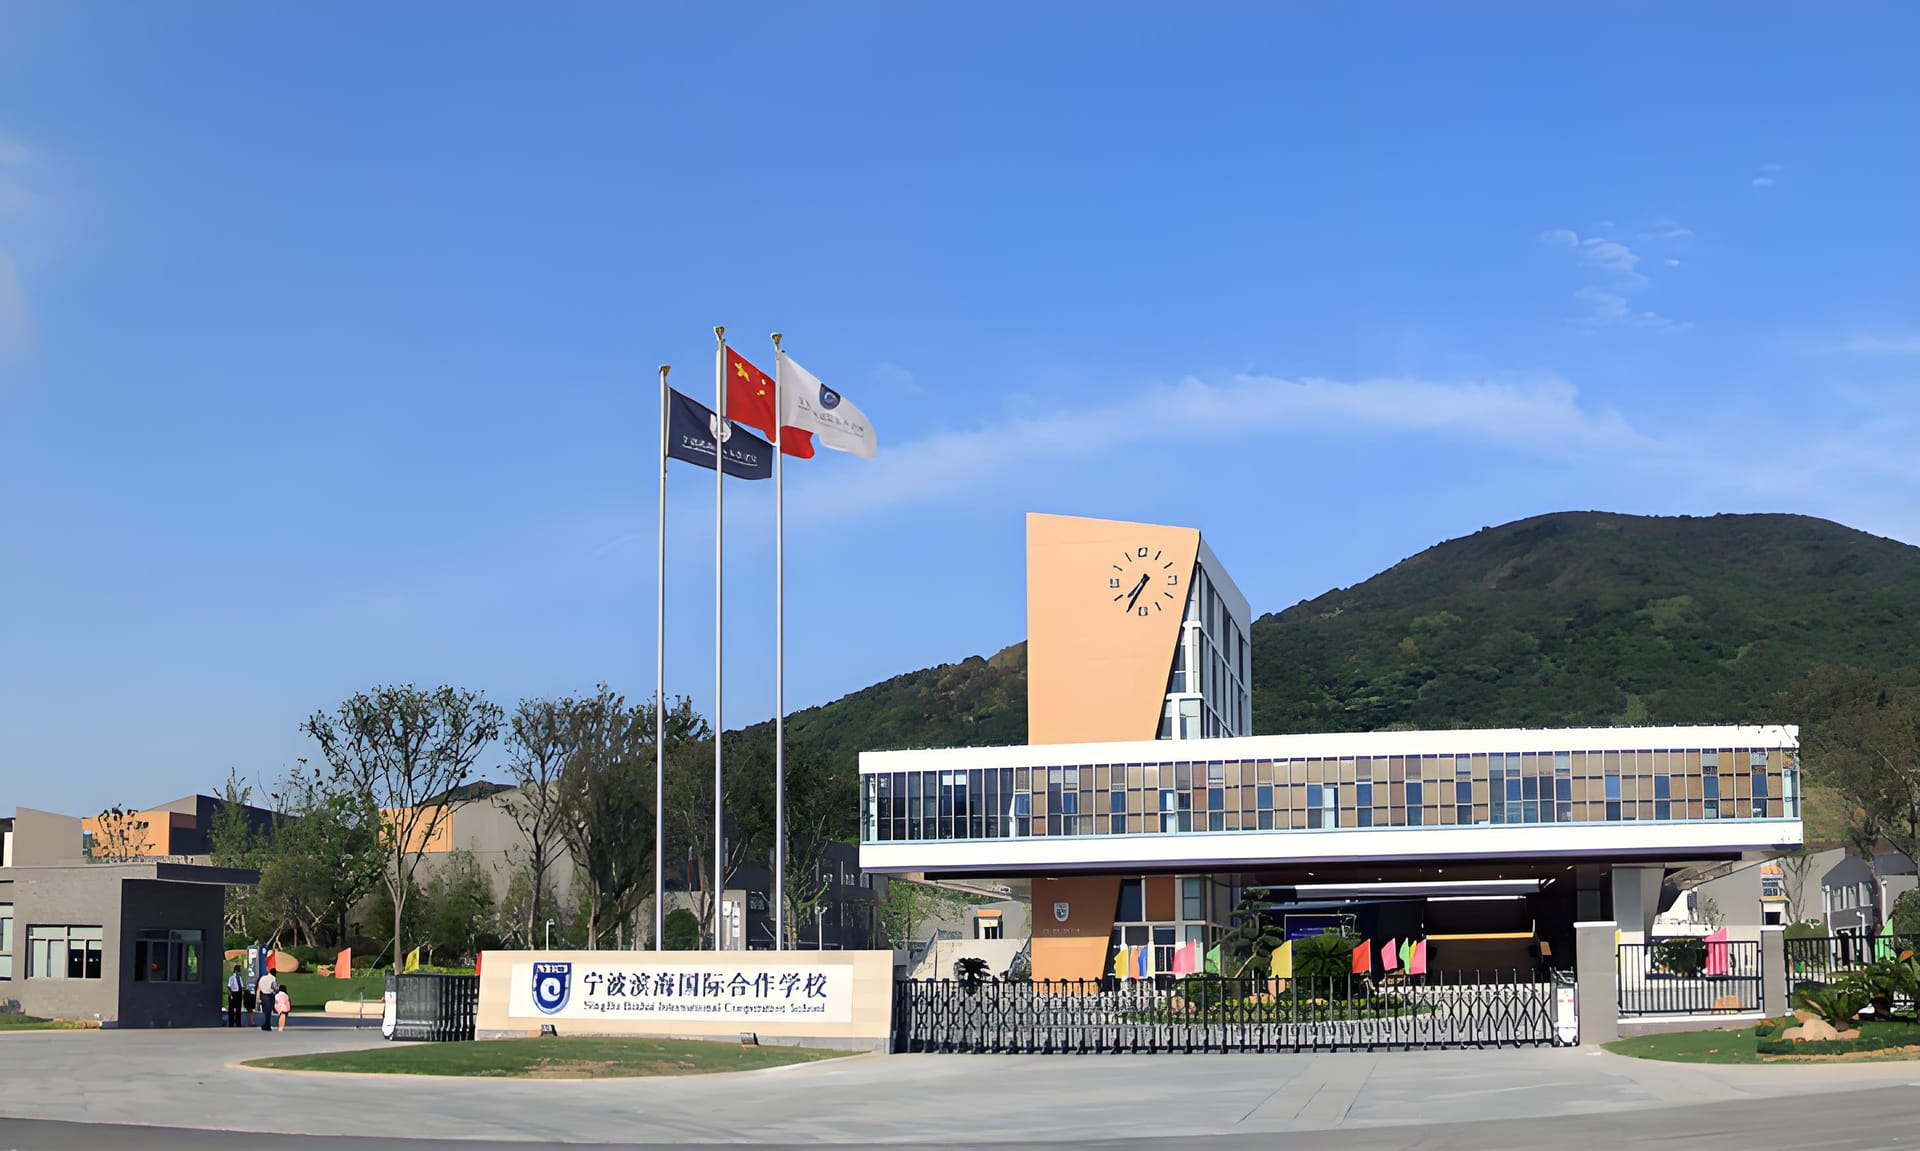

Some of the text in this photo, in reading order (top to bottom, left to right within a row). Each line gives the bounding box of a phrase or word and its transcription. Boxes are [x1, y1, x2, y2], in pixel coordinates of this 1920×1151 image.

[583, 971, 828, 998] 宁波滨海国际合作学校
